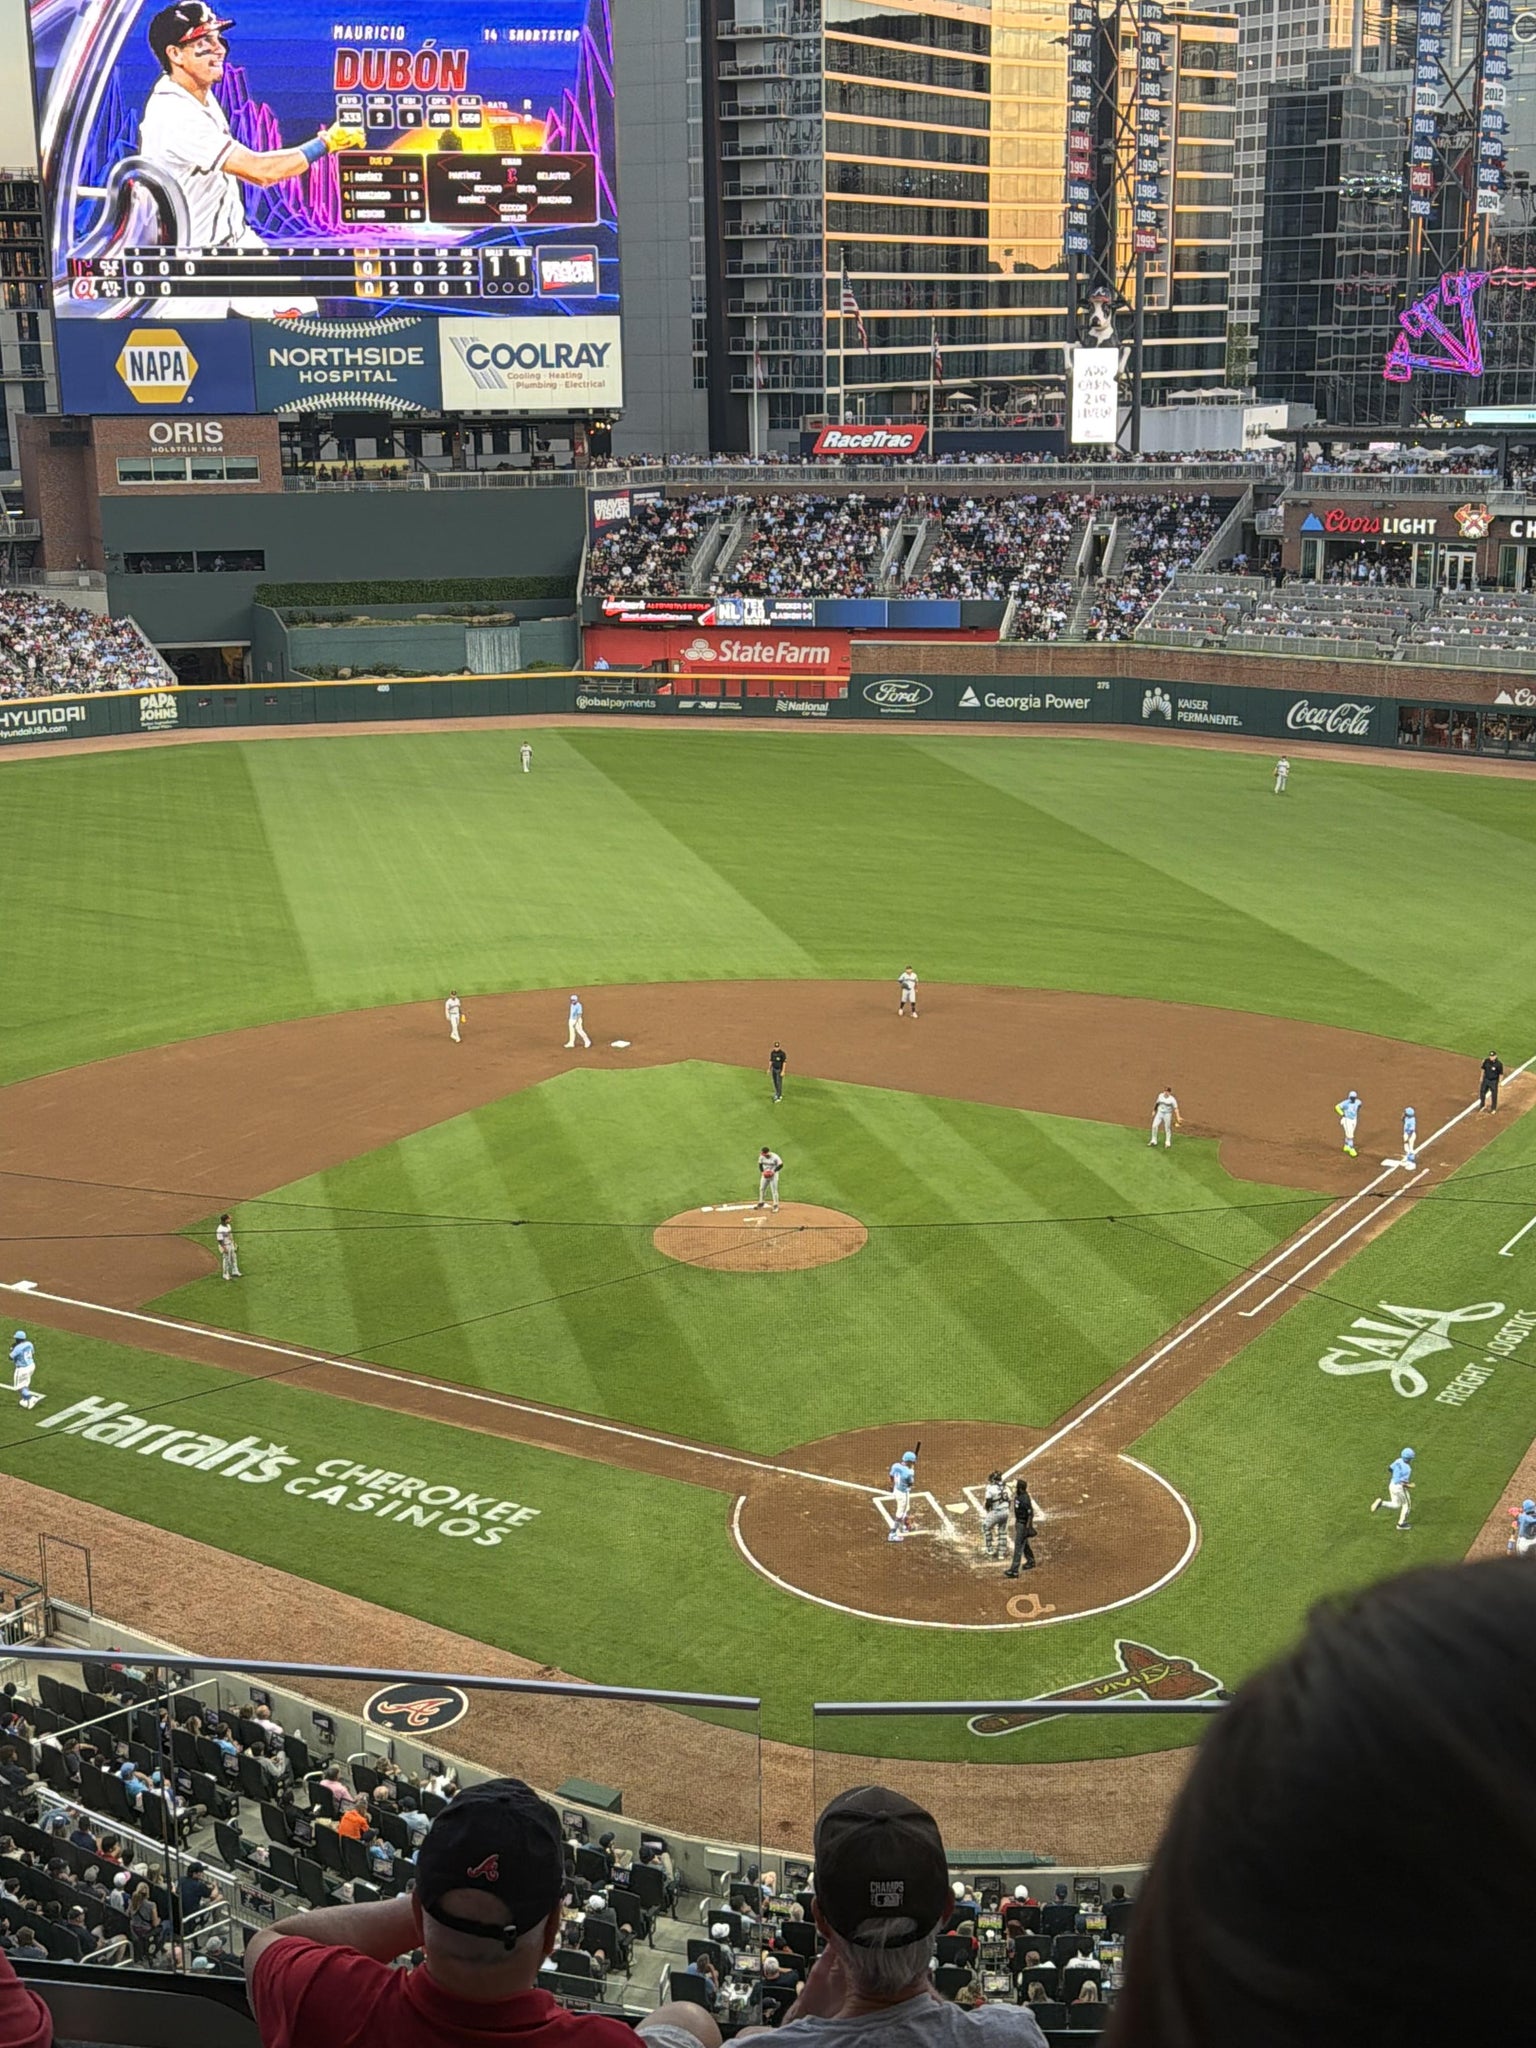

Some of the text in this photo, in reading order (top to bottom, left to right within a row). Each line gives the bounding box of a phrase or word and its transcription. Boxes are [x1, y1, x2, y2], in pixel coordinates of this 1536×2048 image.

[1073, 7, 1092, 22] 1874
[1142, 5, 1162, 19] 1875
[1420, 12, 1441, 26] 2000
[1488, 6, 1509, 20] 2001
[333, 25, 405, 41] MAURICIO
[484, 28, 580, 42] 14 SHORTSTOP
[1141, 31, 1161, 45] 1878
[1487, 33, 1508, 47] 2003
[1073, 34, 1091, 47] 1877
[1420, 39, 1439, 53] 2002
[333, 39, 469, 91] DUBÓN
[1072, 59, 1092, 73] 1883
[1141, 57, 1160, 70] 1891
[1486, 60, 1506, 74] 2005
[1418, 66, 1438, 79] 2004
[1072, 85, 1091, 99] 1892
[1140, 82, 1160, 96] 1893
[1485, 88, 1503, 101] 2012
[1417, 93, 1436, 106] 2010
[376, 112, 384, 123] 2
[1071, 110, 1090, 124] 1897
[1140, 108, 1160, 121] 1898
[1415, 119, 1435, 133] 2013
[1482, 115, 1502, 129] 2018
[1070, 136, 1089, 149] 1914
[1139, 134, 1159, 148] 1948
[1414, 146, 1433, 160] 2019
[1481, 141, 1501, 156] 2020
[1070, 161, 1090, 175] 1957
[1138, 159, 1158, 173] 1958
[1412, 173, 1431, 186] 2021
[1480, 168, 1500, 182] 2022
[1070, 186, 1089, 200] 1969
[1137, 184, 1157, 198] 1982
[1411, 200, 1430, 214] 2023
[1479, 195, 1498, 209] 2024
[1069, 212, 1088, 225] 1991
[1137, 210, 1157, 223] 1992
[1068, 236, 1087, 249] 1993
[1136, 234, 1156, 248] 1995
[133, 261, 144, 275] 0
[159, 261, 169, 275] 0
[184, 261, 195, 275] 0
[363, 261, 373, 275] 0
[389, 261, 397, 275] 1
[413, 261, 423, 275] 0
[438, 261, 448, 275] 2
[462, 261, 473, 275] 2
[490, 256, 526, 276] 1 1
[135, 281, 145, 295] 0
[161, 281, 171, 295] 0
[364, 281, 374, 295] 0
[389, 281, 399, 295] 2
[414, 281, 424, 295] 0
[439, 281, 448, 295] 0
[464, 281, 471, 294] 1
[269, 347, 424, 367] NORTHSIDE
[466, 343, 612, 370] COOLRAY
[129, 350, 186, 381] NAPA
[299, 369, 397, 383] HOSPITAL
[507, 372, 583, 381] Cooling Heating
[516, 380, 605, 389] Plumbing Electrical
[149, 422, 223, 444] ORIS
[822, 431, 913, 448] RaceTrac
[594, 497, 630, 510] BRAVES
[594, 507, 630, 521] VISION
[1324, 508, 1380, 533] Coors
[1383, 517, 1437, 534] LIGHT
[719, 602, 741, 620] NL
[875, 683, 920, 702] Ford
[140, 693, 177, 710] PAPA
[788, 701, 829, 712] National
[985, 693, 1091, 711] Georgia Power
[1177, 698, 1208, 710] KAISER
[0, 706, 86, 727] HYUNDAI
[140, 708, 178, 721] JOHNS
[1177, 711, 1240, 726] PERMANENTE
[1287, 699, 1376, 735] Coca-Cola
[1434, 1362, 1495, 1407] FREIGHT
[315, 1459, 542, 1528] CHEROKEE
[284, 1477, 513, 1547] CASINOS
[870, 1881, 904, 1893] CHAMPS
